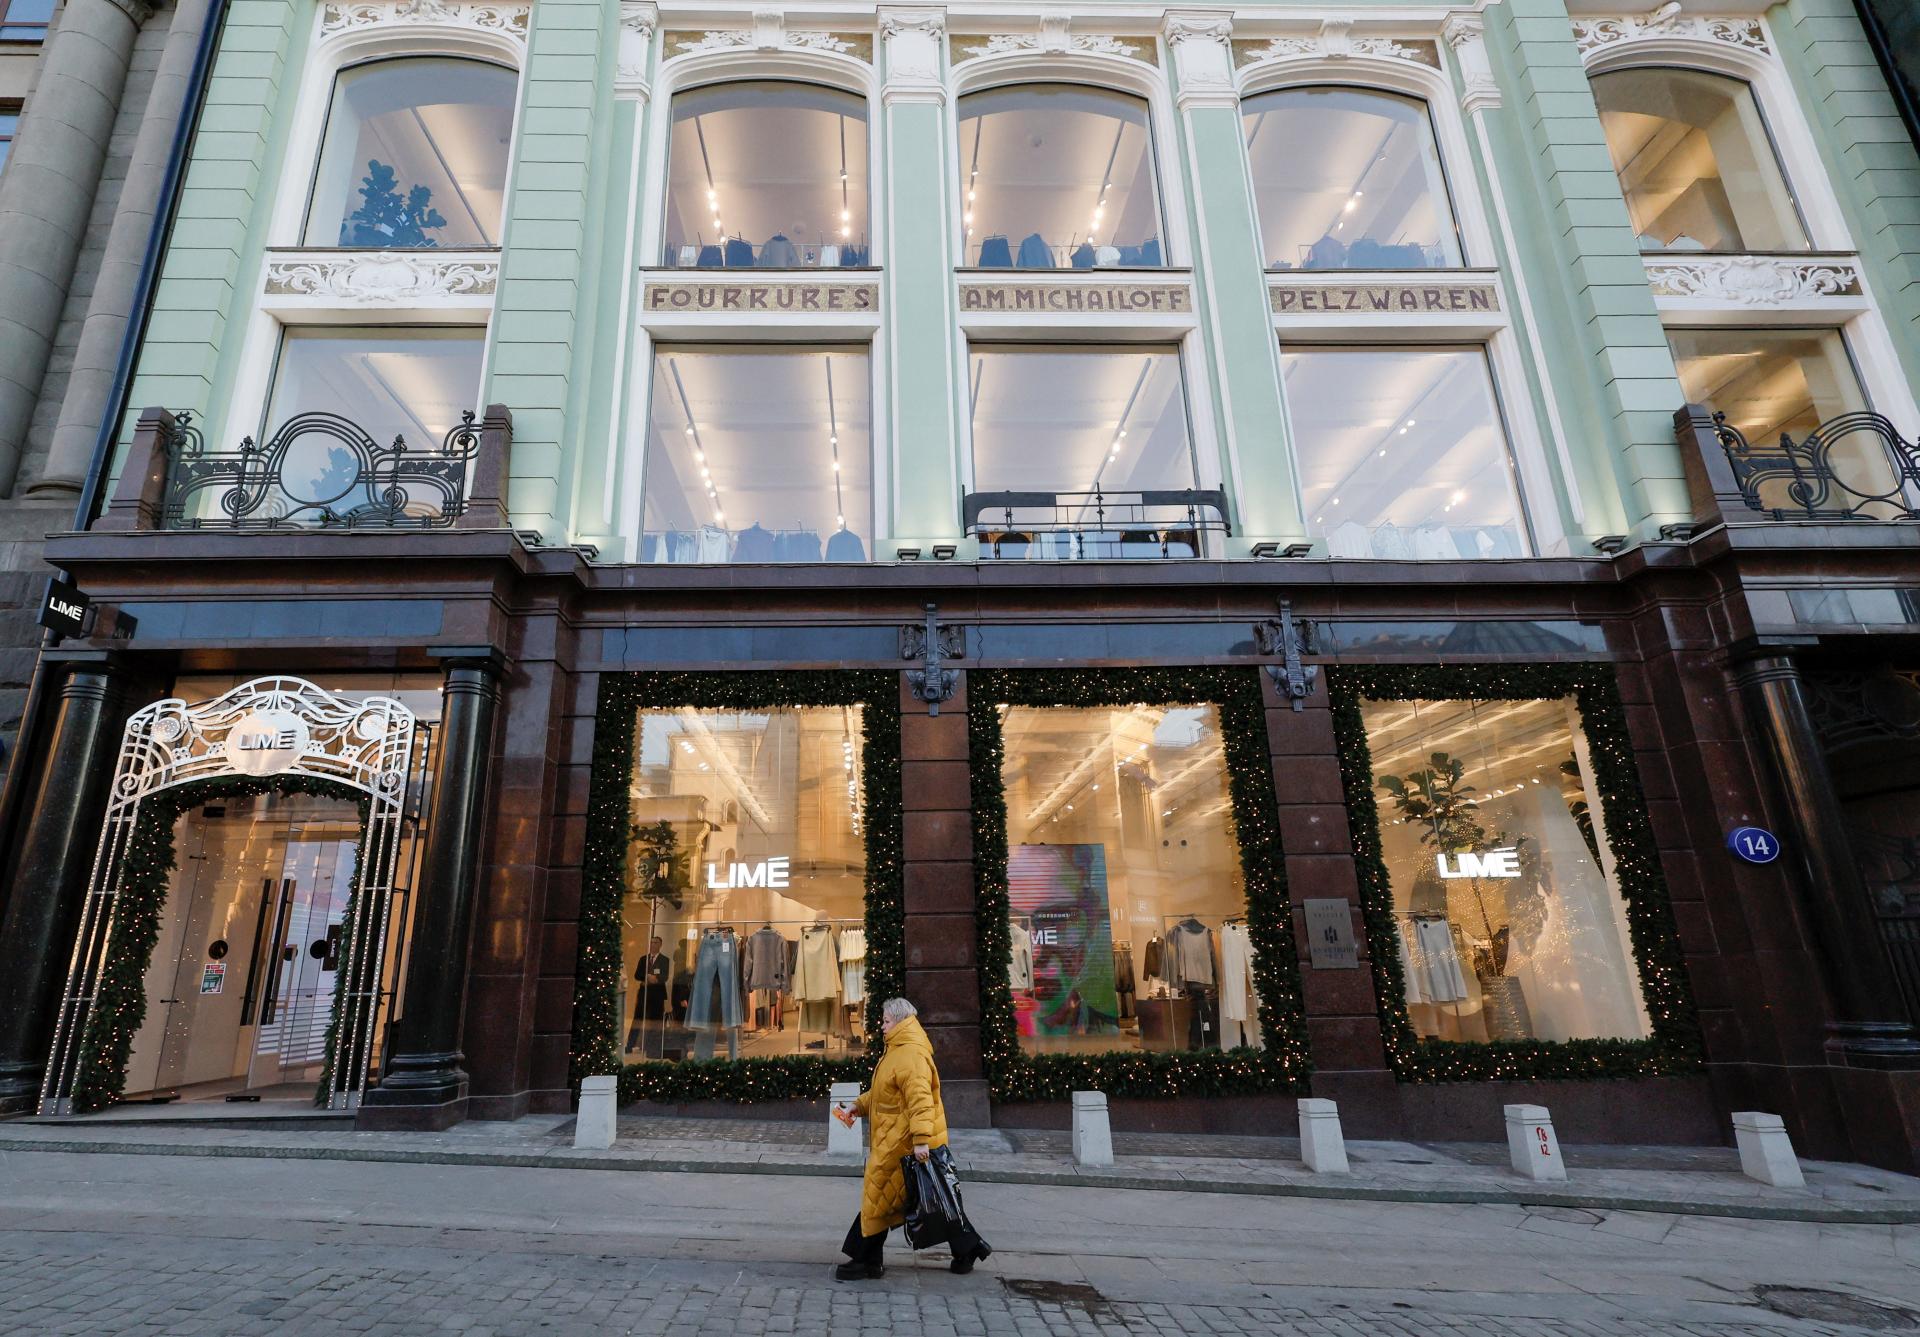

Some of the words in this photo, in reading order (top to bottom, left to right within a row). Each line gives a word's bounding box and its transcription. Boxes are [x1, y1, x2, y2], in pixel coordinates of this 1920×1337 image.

[651, 288, 870, 309] FOURRURES
[1279, 289, 1490, 310] PELZWAREN
[1743, 835, 1770, 855] 14
